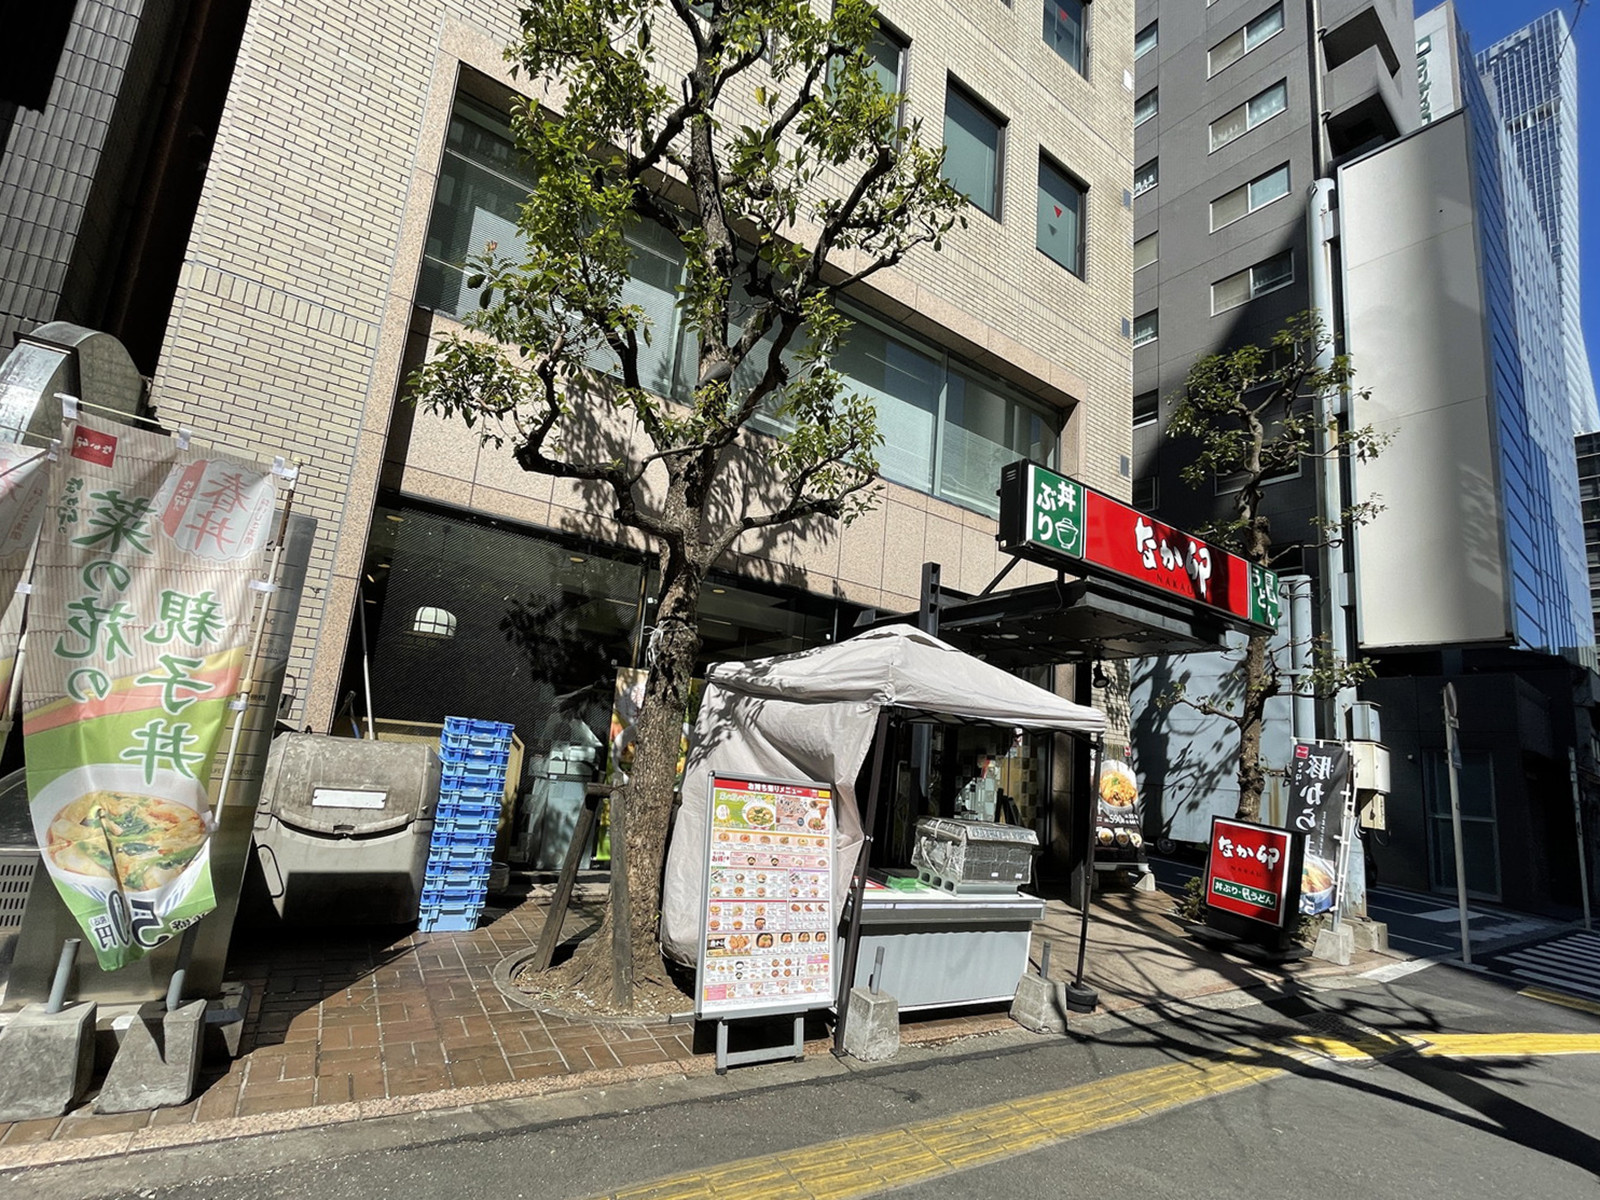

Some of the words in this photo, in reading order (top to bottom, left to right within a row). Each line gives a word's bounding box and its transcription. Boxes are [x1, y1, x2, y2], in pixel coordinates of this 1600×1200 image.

[1036, 480, 1077, 541] 丼ぶり
[1135, 516, 1212, 599] なか卯
[1156, 573, 1193, 595] NAKAU
[748, 782, 803, 795] お持ち帰りメニュー
[1218, 835, 1280, 871] なか卯
